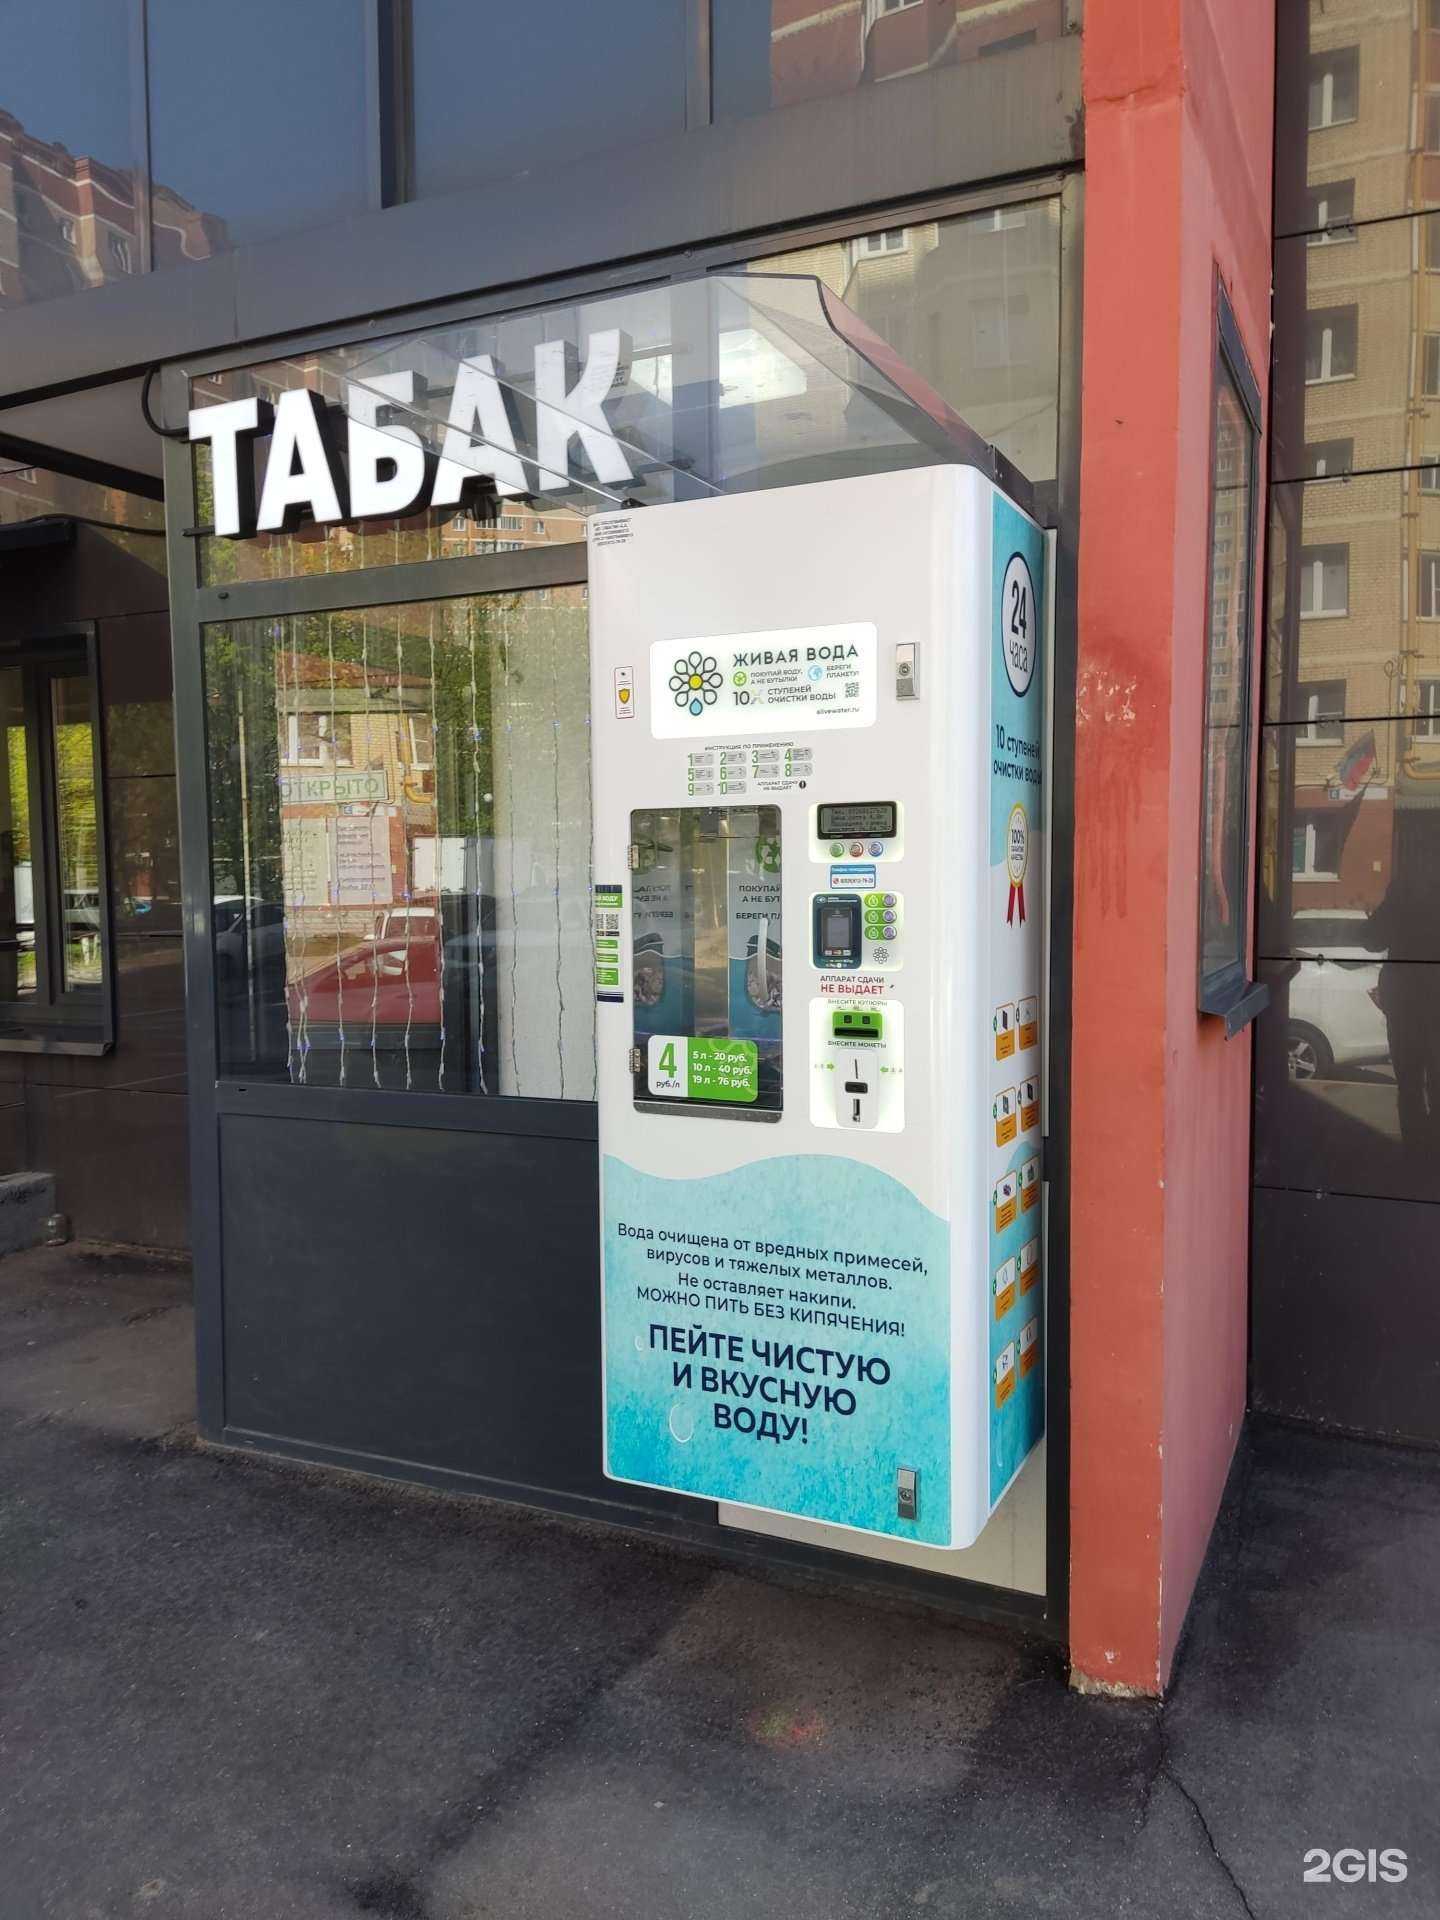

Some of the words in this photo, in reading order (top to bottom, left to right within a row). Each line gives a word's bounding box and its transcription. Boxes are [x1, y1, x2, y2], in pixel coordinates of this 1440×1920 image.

[188, 328, 634, 537] ТАБАК
[1011, 579, 1027, 639] 24
[733, 648, 798, 667] ЖИВАЯ
[806, 644, 859, 661] ВОДА
[1009, 639, 1028, 673] часа
[750, 669, 782, 678] ПОКУПАЙ
[767, 676, 798, 684] БУТЫЛКИ
[767, 685, 812, 695] СТУПЕНЕЙ
[767, 694, 807, 704] ОЧИСТКИ
[809, 692, 836, 701] ВОДЫ
[816, 707, 860, 715] alivewater.ru
[996, 724, 1005, 750] 10
[1006, 736, 1041, 761] ступеней
[688, 753, 694, 766] 1
[720, 751, 727, 765] 2
[752, 750, 759, 763] 3
[784, 748, 792, 762] 4
[688, 768, 694, 781] 5
[720, 766, 727, 780] 6
[752, 765, 760, 779] 7
[784, 764, 792, 777] 8
[993, 759, 1024, 781] очистки
[281, 778, 379, 798] ОТКРЫТО
[688, 782, 694, 796] 9
[742, 895, 750, 903] А
[751, 895, 762, 903] НЕ
[736, 912, 768, 920] БЕРЕГИ
[858, 976, 885, 984] СДАЧИ
[820, 984, 835, 993] НЕ
[838, 984, 885, 995] ВЫДАЕТ
[857, 1041, 887, 1049] МОНЕТЫ
[658, 1042, 678, 1078] 4
[692, 1052, 699, 1060] 5
[713, 1052, 726, 1061] 20
[727, 1053, 748, 1063] руб.
[693, 1063, 702, 1071] 10
[718, 1065, 731, 1073] 40
[732, 1065, 753, 1075] руб.
[718, 1077, 729, 1087] 76
[731, 1078, 751, 1088] руб.
[618, 1223, 654, 1240] Вода
[658, 1230, 729, 1249] очищена
[733, 1239, 751, 1251] от
[755, 1241, 829, 1261] вредных
[833, 1251, 928, 1276] примесей,
[647, 1249, 710, 1266] вирусов
[715, 1257, 724, 1268] и
[729, 1258, 800, 1278] тяжелых
[805, 1268, 893, 1290] металлов.
[678, 1272, 699, 1287] Не
[703, 1278, 784, 1299] оставляет
[789, 1290, 856, 1309] накипи.
[637, 1286, 700, 1307] МОЖНО
[705, 1295, 749, 1314] ПИТЬ
[754, 1302, 785, 1319] БЕЗ
[790, 1307, 905, 1337] КИПЯЧЕНИЯ!
[650, 1323, 744, 1362] ПЕЙТЕ
[752, 1338, 891, 1385] ЧИСТУЮ
[673, 1361, 692, 1388] И
[701, 1366, 857, 1416] ВКУСНУЮ
[714, 1402, 808, 1444] ВОДУ!
